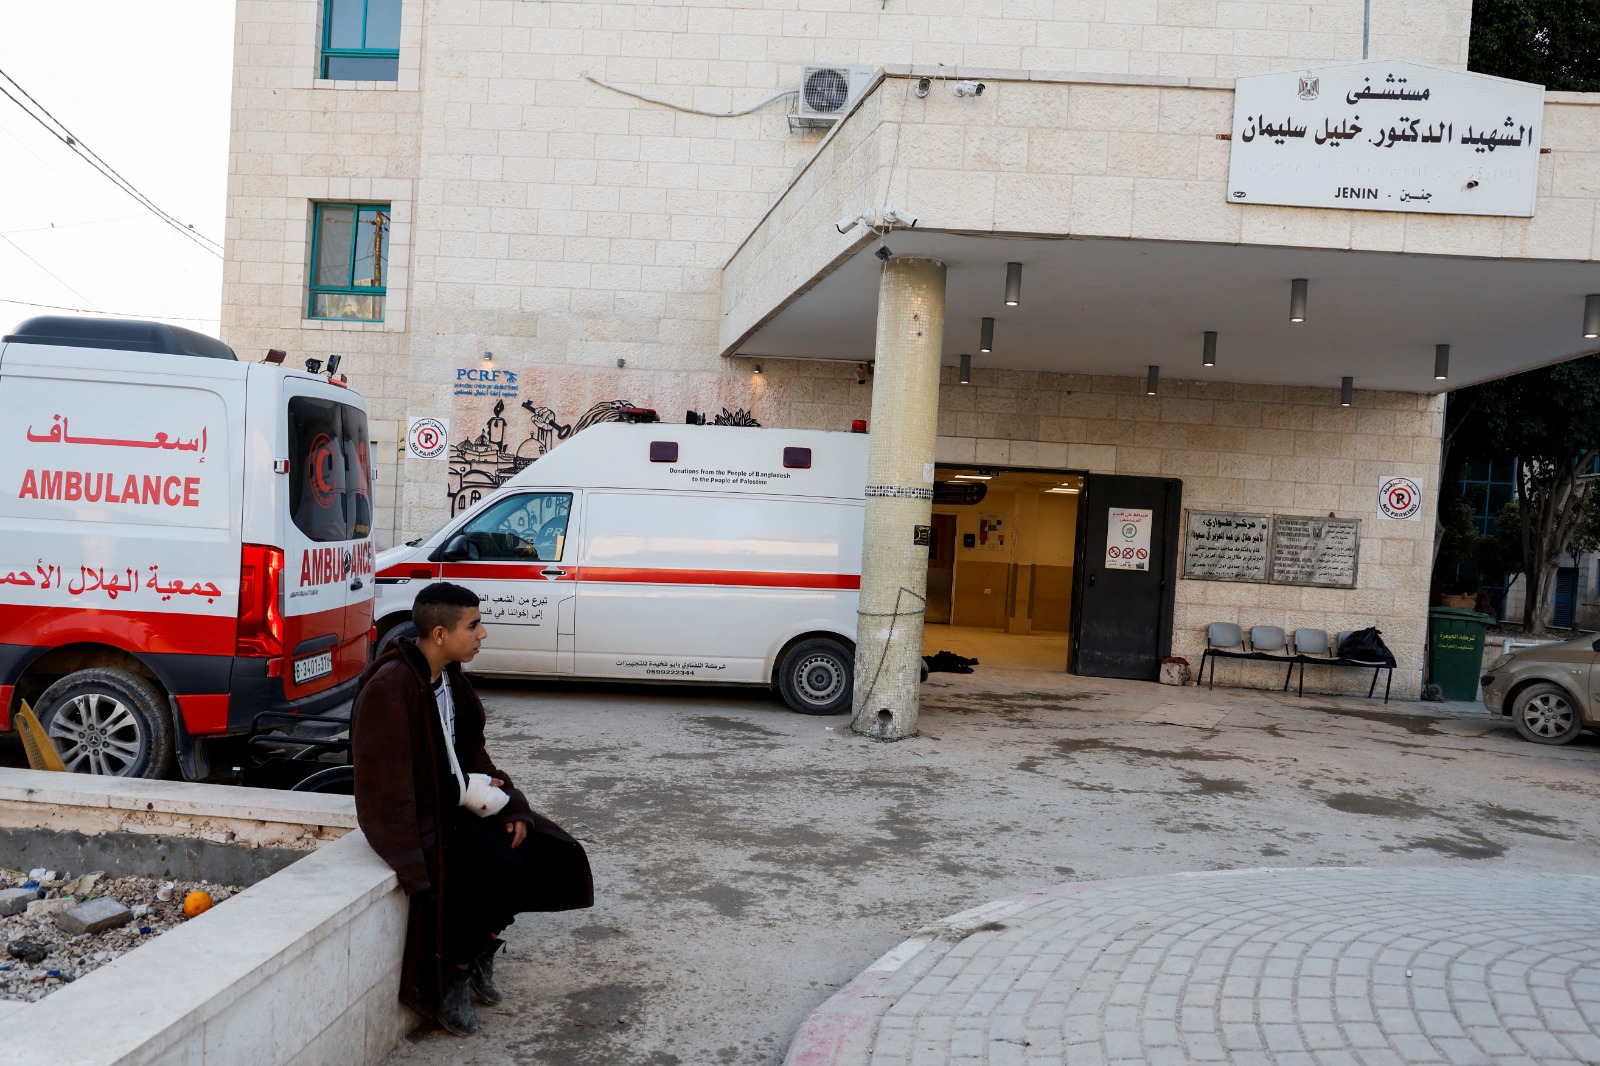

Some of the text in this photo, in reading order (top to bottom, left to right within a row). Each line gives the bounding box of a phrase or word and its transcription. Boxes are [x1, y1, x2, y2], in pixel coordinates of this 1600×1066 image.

[1346, 73, 1430, 104] مستشفى
[1242, 114, 1308, 145] سليمان
[1314, 115, 1363, 147] خليل
[1460, 116, 1533, 153] الشهيد
[1335, 187, 1379, 200] JENIN
[1400, 189, 1433, 204] جنين
[457, 368, 501, 381] PCRF
[26, 413, 207, 463] إسعاف
[412, 442, 418, 451] NO
[419, 444, 444, 456] PARKING
[18, 469, 200, 507] AMBULANCE
[1382, 504, 1417, 517] NO PARKING
[1234, 519, 1256, 529] مركز
[299, 541, 372, 587] AMBULANCE
[0, 558, 222, 604] جمعية الهلال الأحم
[492, 594, 514, 604] الشعب
[518, 597, 530, 605] من
[495, 607, 504, 619] في
[532, 610, 543, 619] إلى
